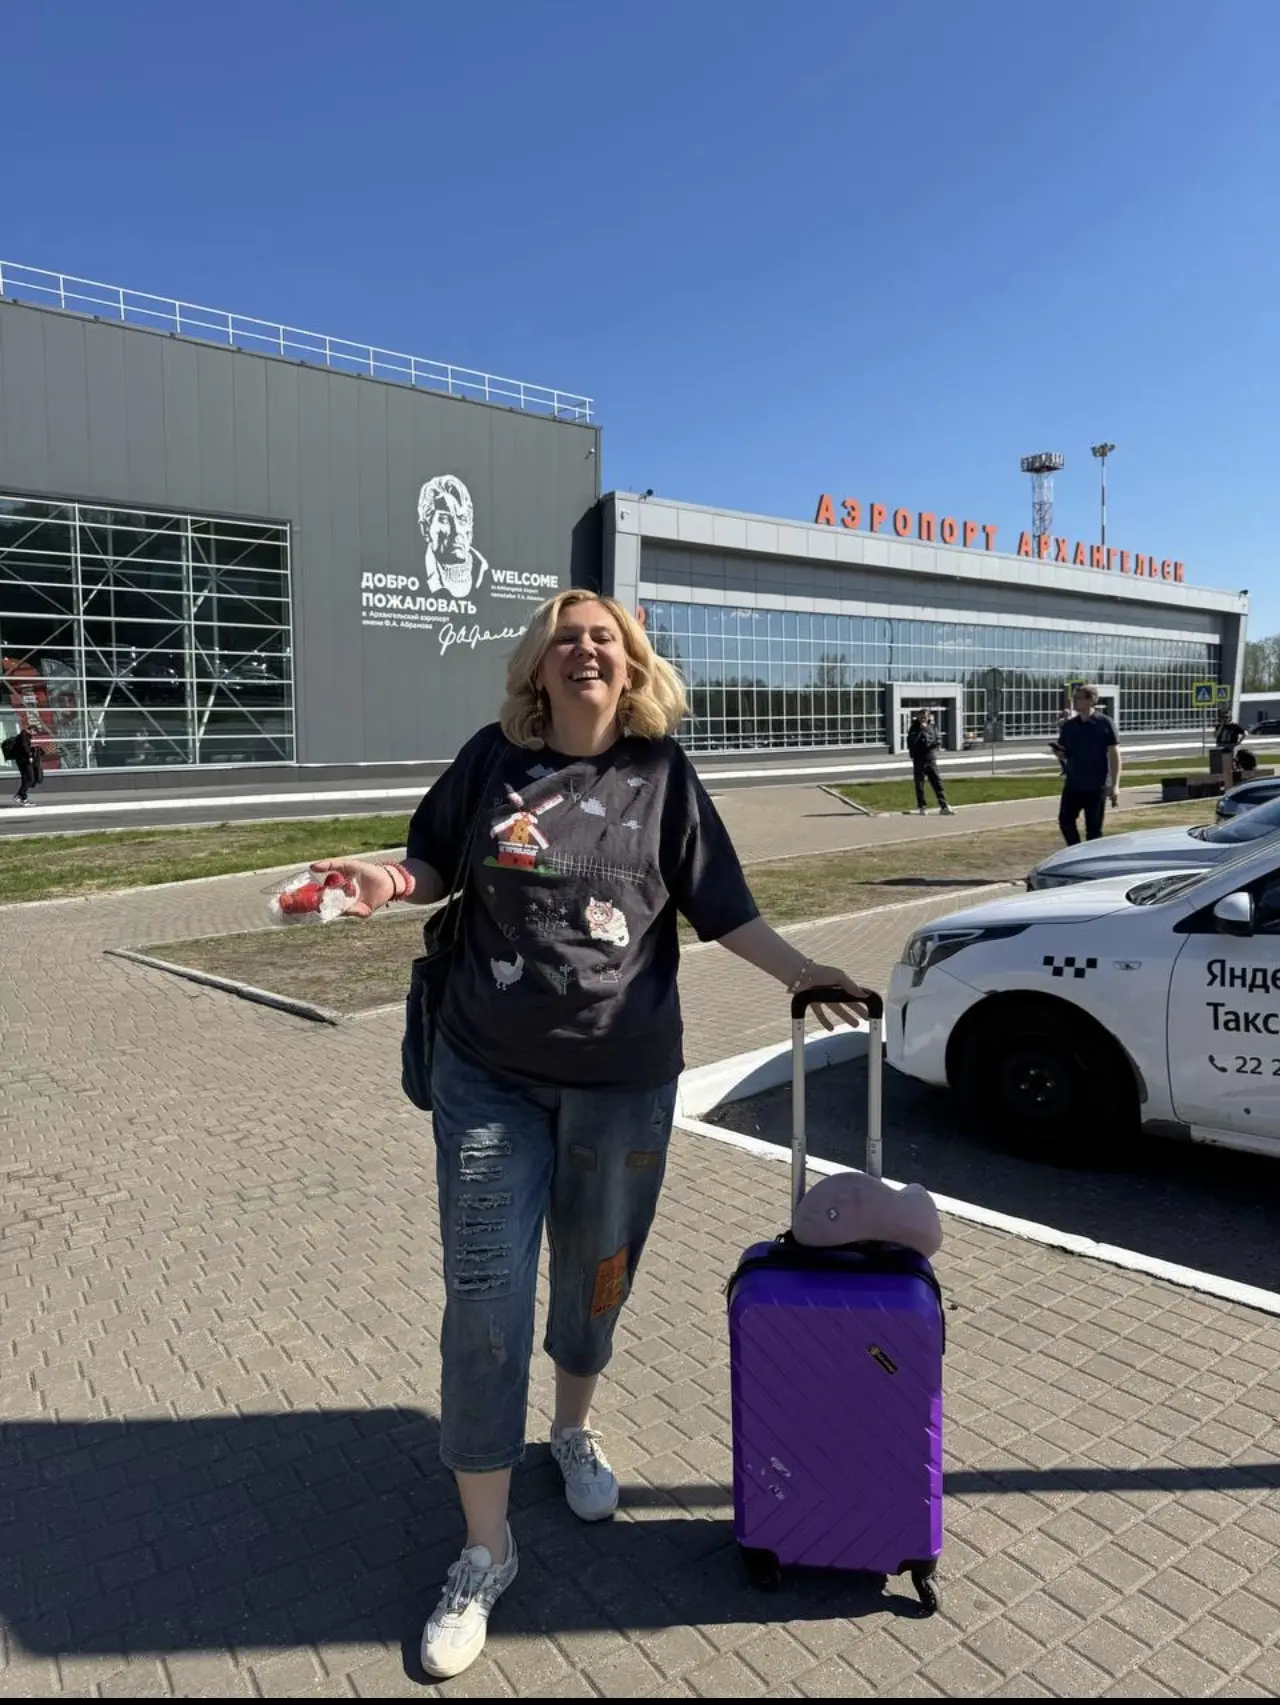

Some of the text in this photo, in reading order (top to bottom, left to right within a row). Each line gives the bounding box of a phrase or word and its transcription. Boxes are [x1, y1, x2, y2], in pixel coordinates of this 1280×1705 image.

[815, 493, 1185, 583] АЭРОПОРТ АРХАНГЕЛЬСК
[361, 572, 420, 591] ДОБРО
[491, 569, 559, 589] WELCOME
[362, 592, 477, 615] ПОЖАЛОВАТЬ
[1205, 1001, 1280, 1035] Такс
[1235, 1055, 1263, 1075] 22
